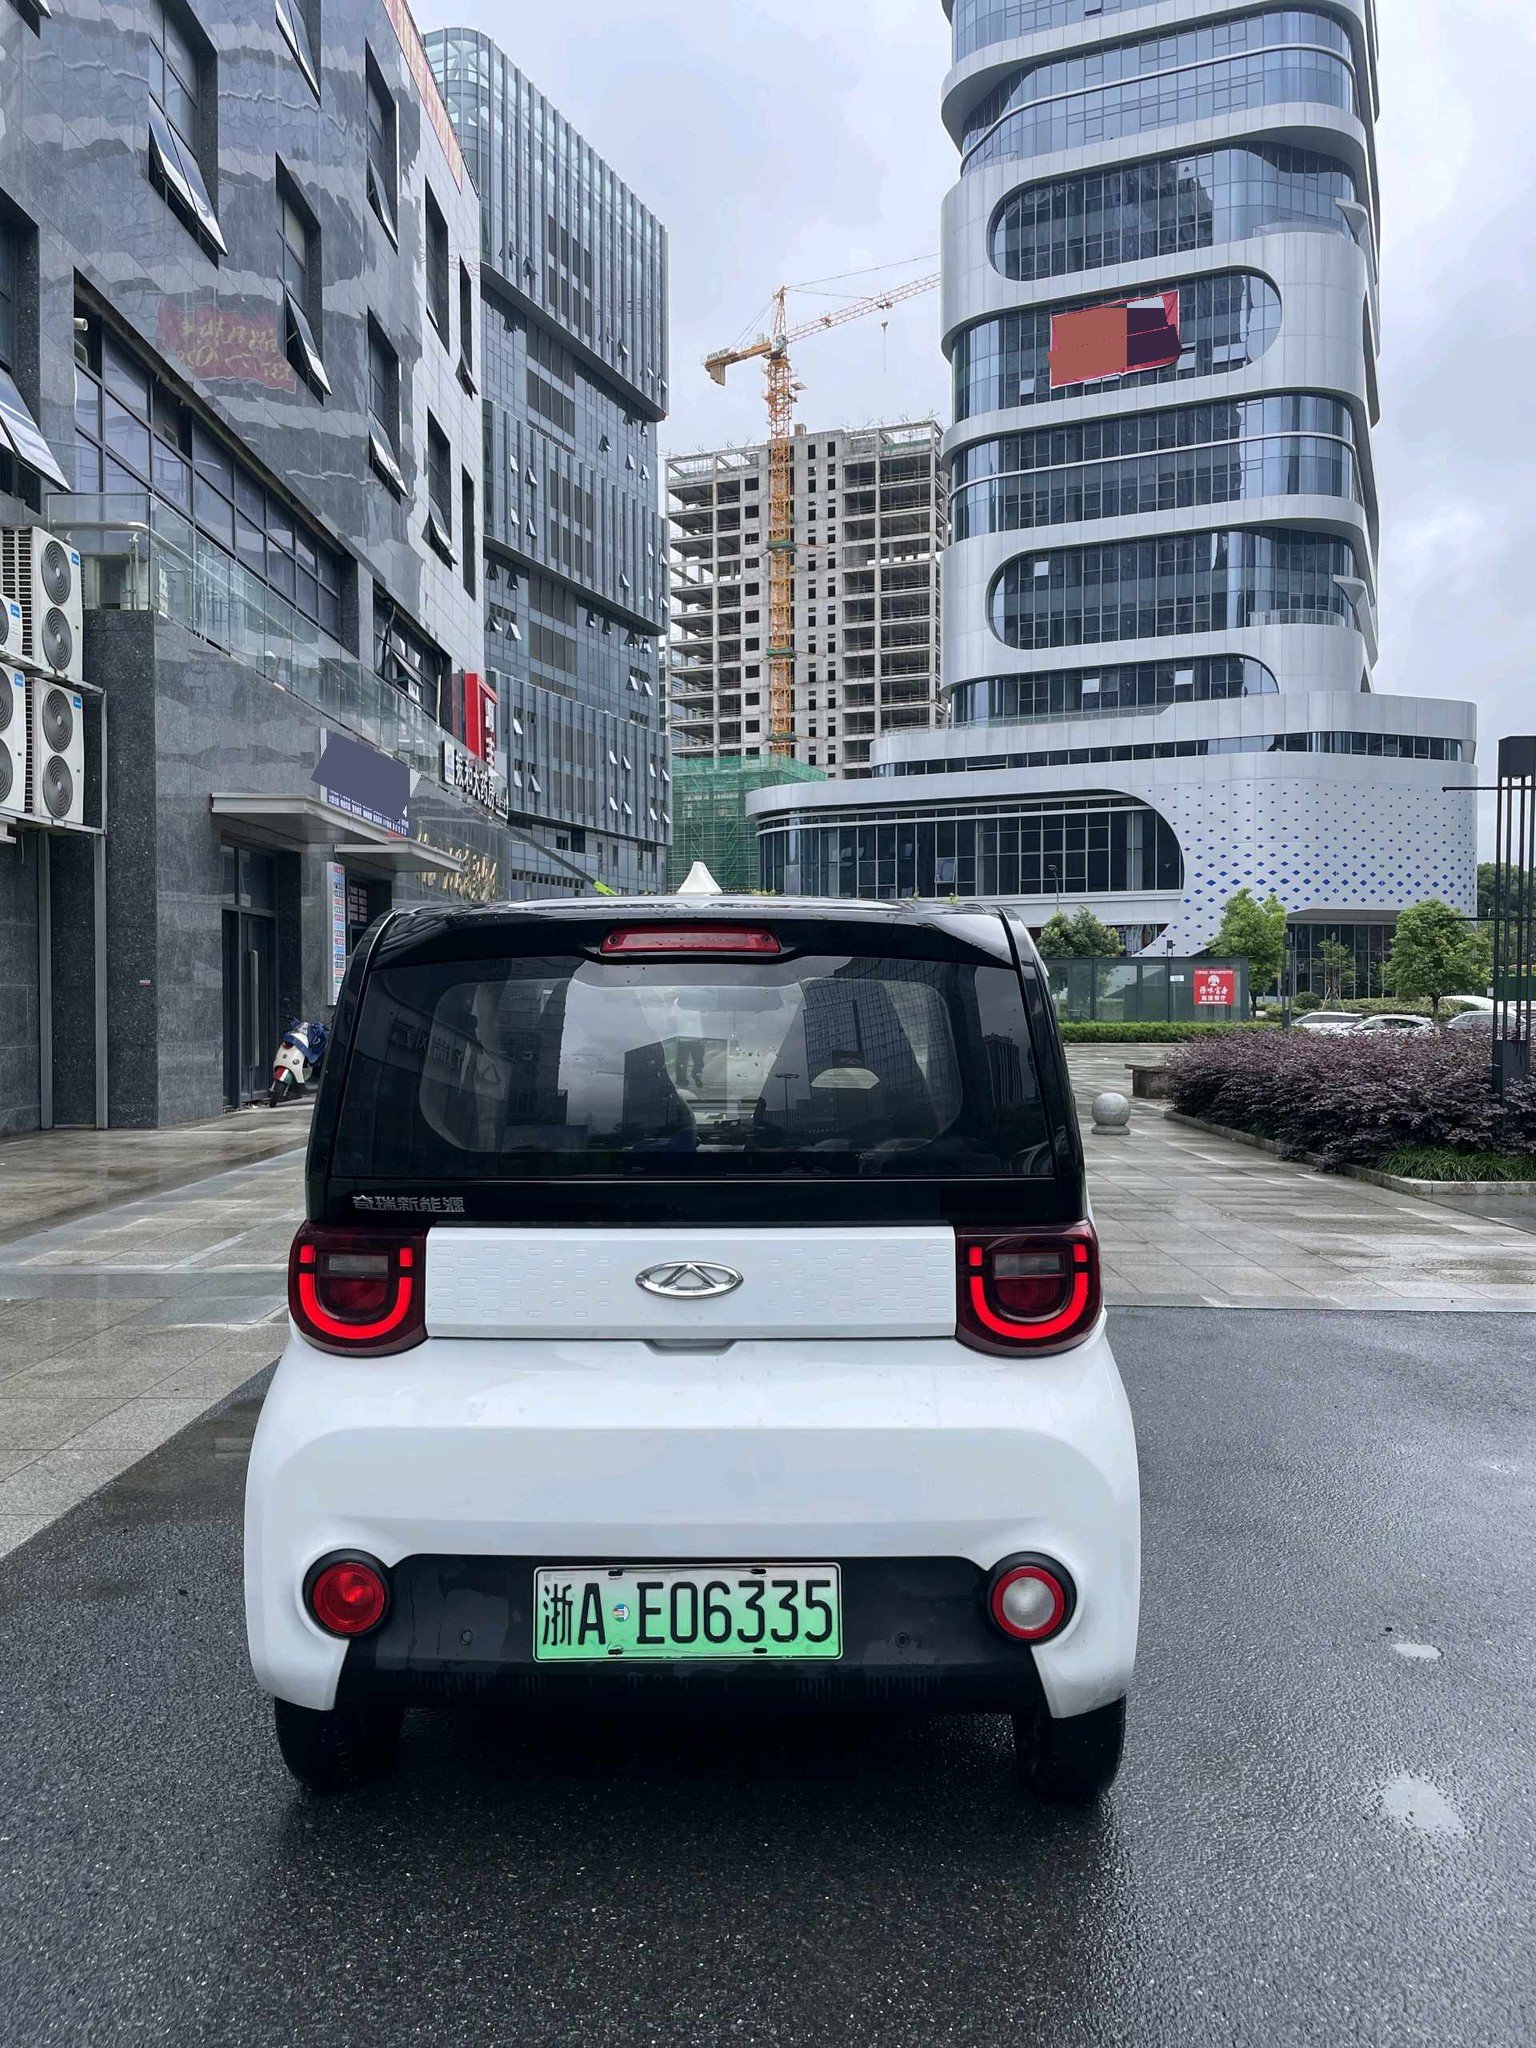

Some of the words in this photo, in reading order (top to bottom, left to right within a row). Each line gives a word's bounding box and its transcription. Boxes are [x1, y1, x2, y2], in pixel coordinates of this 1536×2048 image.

[352, 1194, 465, 1213] 奇瑞新能源
[543, 1582, 606, 1646] 浙A
[636, 1579, 833, 1645] E06335
